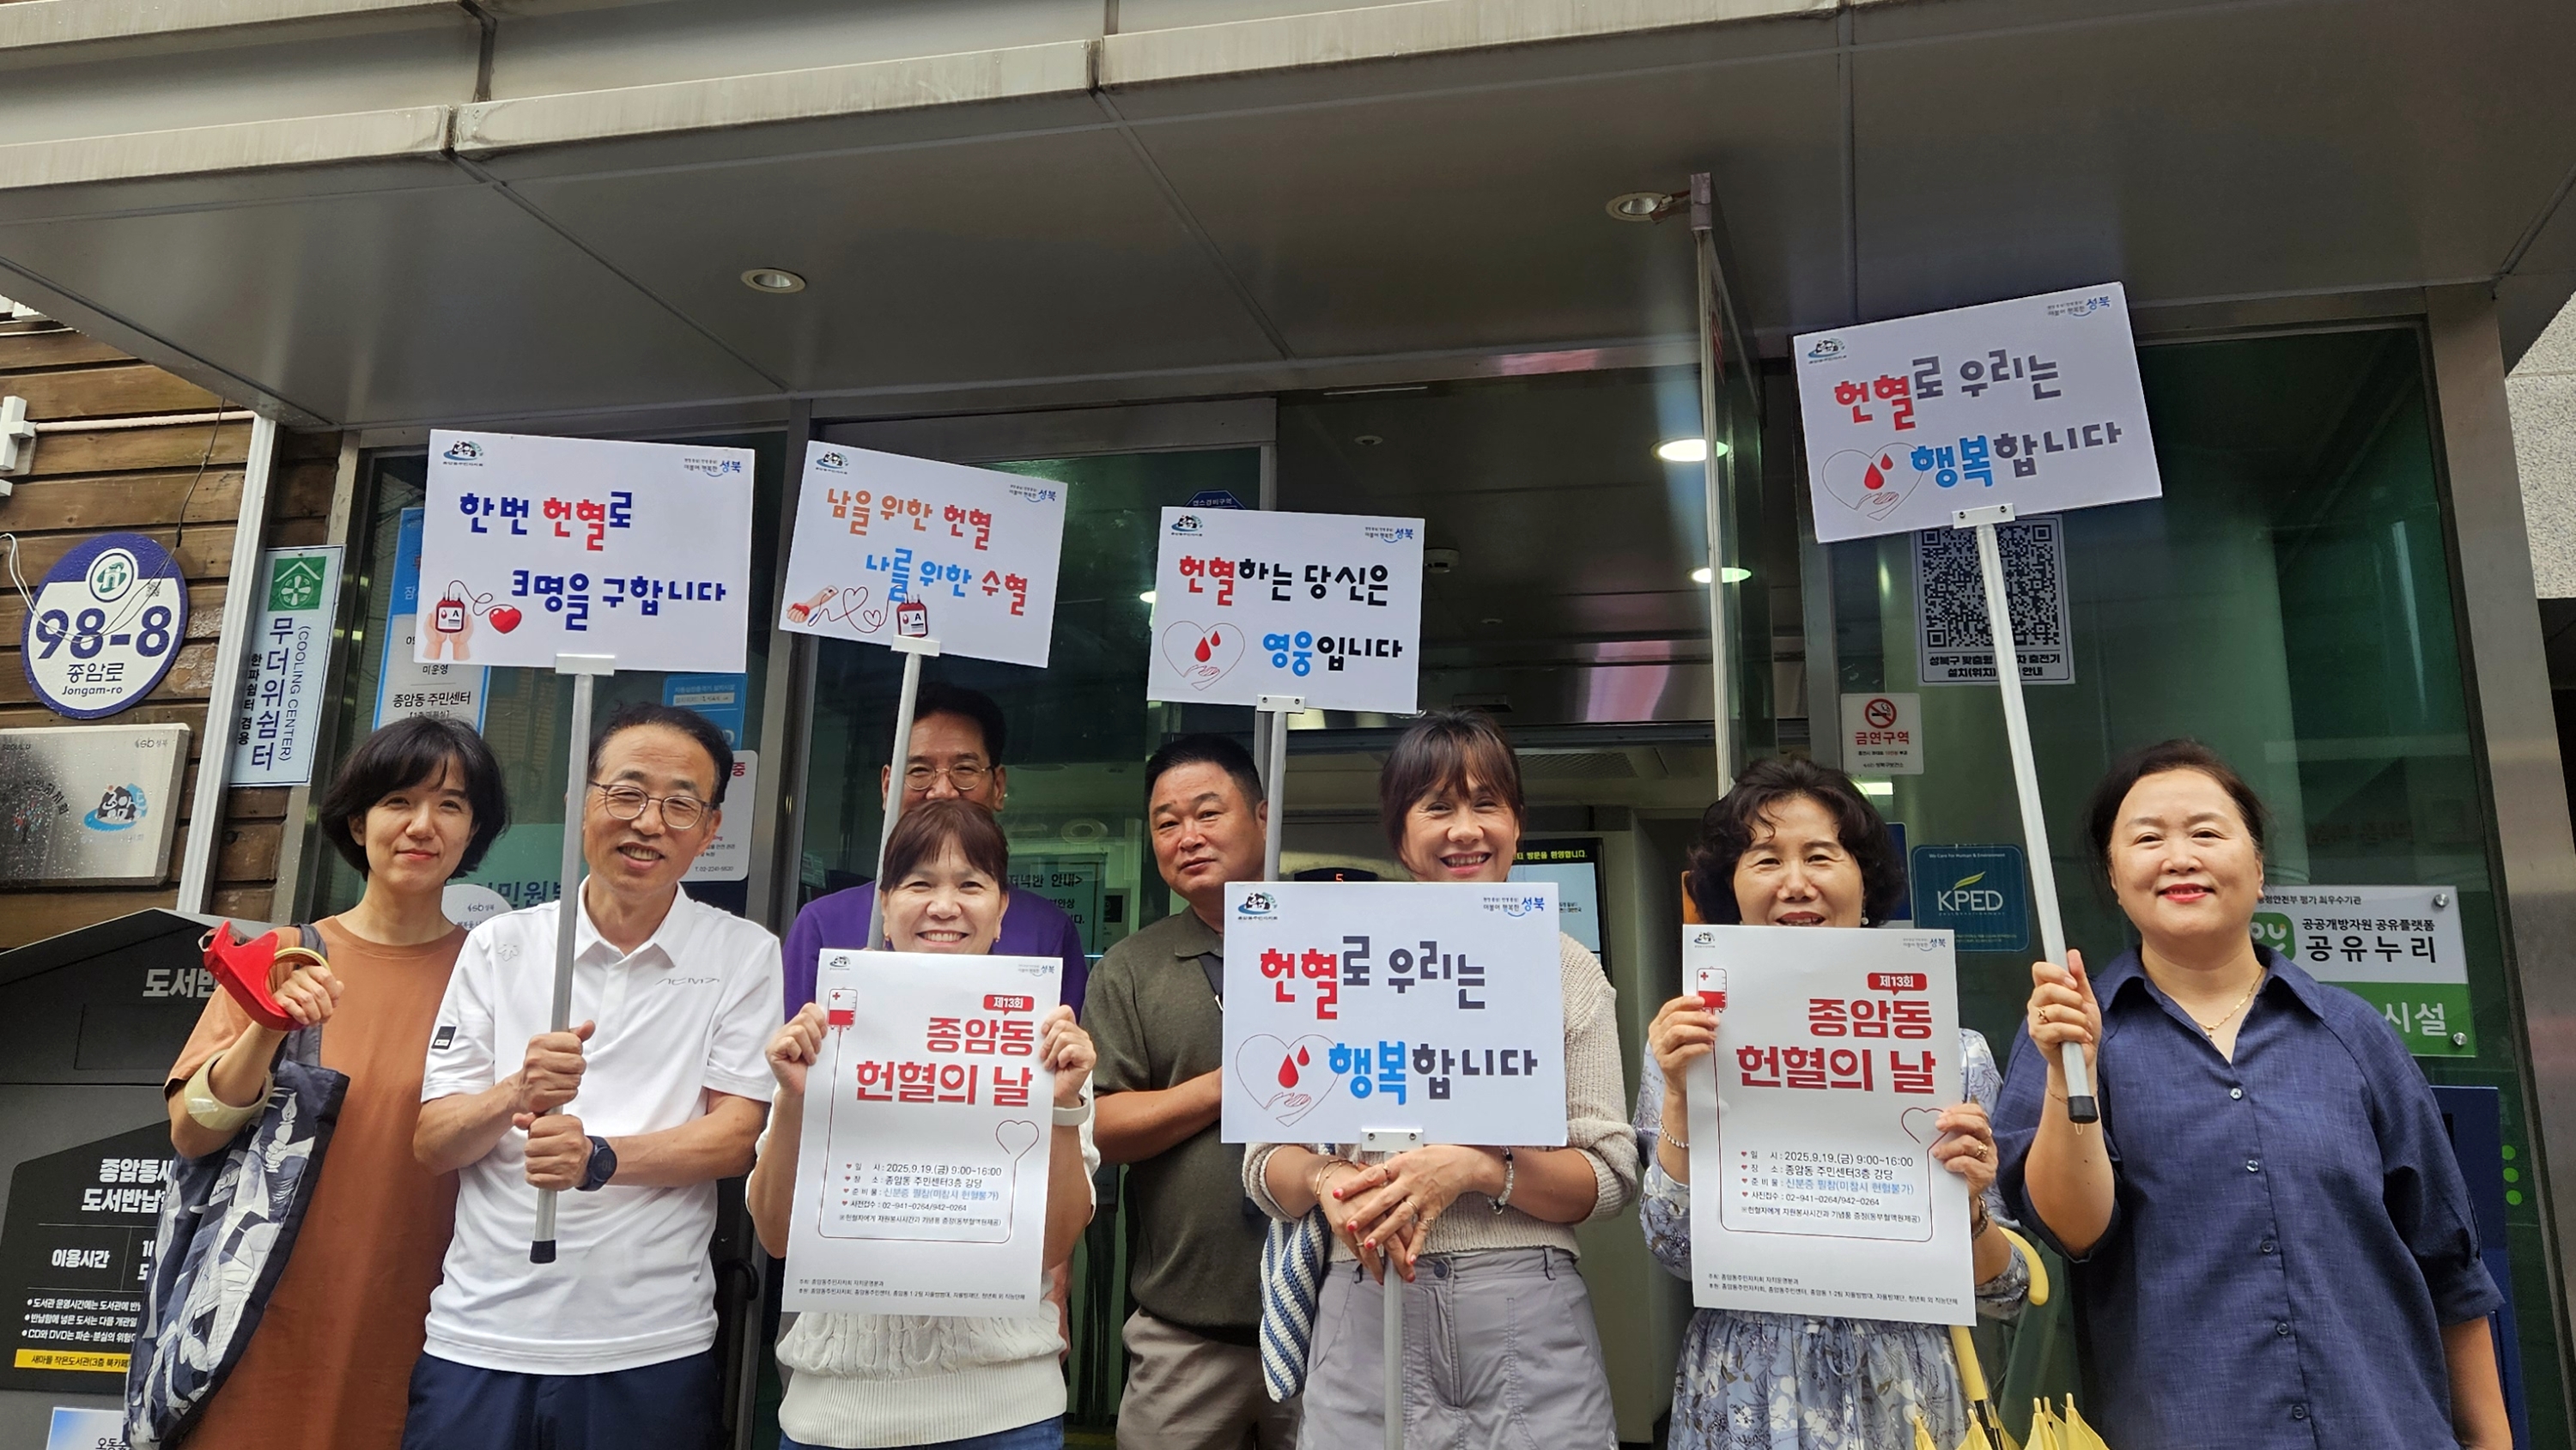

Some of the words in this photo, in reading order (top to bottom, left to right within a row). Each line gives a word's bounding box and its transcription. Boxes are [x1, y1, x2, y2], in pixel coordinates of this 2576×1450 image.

[2086, 295, 2111, 311] 성북
[1834, 355, 1944, 432] 헌혈로
[1959, 349, 2063, 402] 우리는
[1910, 421, 2123, 488] 행복합니다
[720, 460, 742, 473] 성북
[1038, 489, 1057, 501] 성북
[459, 493, 529, 536] 한번
[543, 491, 633, 552] 헌혈로
[827, 488, 872, 537] 남을
[880, 494, 933, 532] 위한
[944, 504, 993, 551] 헌혈
[1394, 528, 1414, 540] 성북
[866, 548, 913, 603] 나를
[919, 561, 972, 598] 위한
[981, 570, 1028, 616] 수혈
[1179, 555, 1293, 607] 헌혈하는
[1304, 564, 1388, 607] 당신은
[511, 569, 590, 632] 3명을
[602, 575, 726, 616] 구합니다
[452, 610, 459, 618] A
[914, 612, 922, 622] A
[34, 605, 173, 660] 98-8
[289, 625, 311, 695] (COOLING
[1262, 631, 1403, 677] 영웅입니다
[1929, 656, 1959, 666] 성북구
[1962, 655, 1993, 664] 맞춤형
[2029, 654, 2060, 664] 충전기
[66, 662, 125, 683] 종암로
[422, 664, 449, 675] 미운영
[1947, 667, 1996, 677] 설치(위치)
[2022, 667, 2044, 676] 안내
[62, 684, 123, 698] Jongam-ro
[252, 617, 294, 771] 무더위쉼터
[392, 692, 426, 707] 종암동
[427, 690, 471, 707] 주민센터
[278, 697, 300, 762] CENTER)
[1856, 731, 1910, 745] 금연구역
[1527, 851, 1547, 860] 방문을
[1551, 850, 1588, 859] 환영합니다.
[1522, 897, 1545, 912] 성북
[1937, 890, 2004, 912] KPED
[2300, 895, 2317, 905] 평가
[2319, 895, 2362, 906] 최우수기관
[2301, 918, 2373, 931] 공공개방자원
[2375, 918, 2436, 932] 공유플랫폼
[2306, 935, 2437, 963] 공유누리
[1260, 936, 1370, 1021] 헌혈로
[1388, 940, 1486, 1010] 우리는
[1880, 974, 1914, 989] 제13회
[993, 997, 1024, 1010] 제13회
[1808, 998, 1933, 1040] 종암동
[927, 1016, 1036, 1056] 종암동
[1328, 1040, 1539, 1106] 행복합니다
[1736, 1045, 1874, 1093] 헌혈의
[1889, 1049, 1936, 1095] 날
[856, 1060, 976, 1105] 헌혈의
[993, 1065, 1034, 1107] 날
[1750, 1150, 1758, 1160] 일
[1784, 1150, 1854, 1165] 2025.9.19.(금)
[1856, 1154, 1914, 1168] 9:00~16:00
[886, 1163, 949, 1175] 2025.9.19.(금)
[951, 1165, 1002, 1177] 9:00~16:00
[1785, 1164, 1814, 1177] 종암동
[1817, 1166, 1871, 1180] 주민센터3층
[1874, 1168, 1893, 1181] 강당
[885, 1175, 911, 1186] 종암동
[914, 1177, 962, 1188] 주민센터3층
[965, 1179, 982, 1189] 강당
[1785, 1178, 1814, 1191] 신분증
[1871, 1182, 1914, 1195] 헌혈불가)
[884, 1187, 910, 1198] 신분증
[1785, 1193, 1880, 1206] 02-941-0264/942-0264
[882, 1202, 967, 1212] 02-941-0264/942-0264
[51, 1249, 110, 1269] 이용시간
[33, 1298, 56, 1309] 도서관
[56, 1298, 99, 1310] 운영시간에는
[99, 1301, 129, 1312] 도서관에
[30, 1313, 59, 1325] 반납함에
[61, 1313, 76, 1325] 넣은
[76, 1315, 98, 1326] 도서는
[99, 1316, 115, 1326] 다음
[27, 1329, 48, 1339] CD와
[49, 1329, 75, 1340] DVD는
[31, 1355, 53, 1363] 새마을
[55, 1356, 104, 1367] 작은도서관(3층
